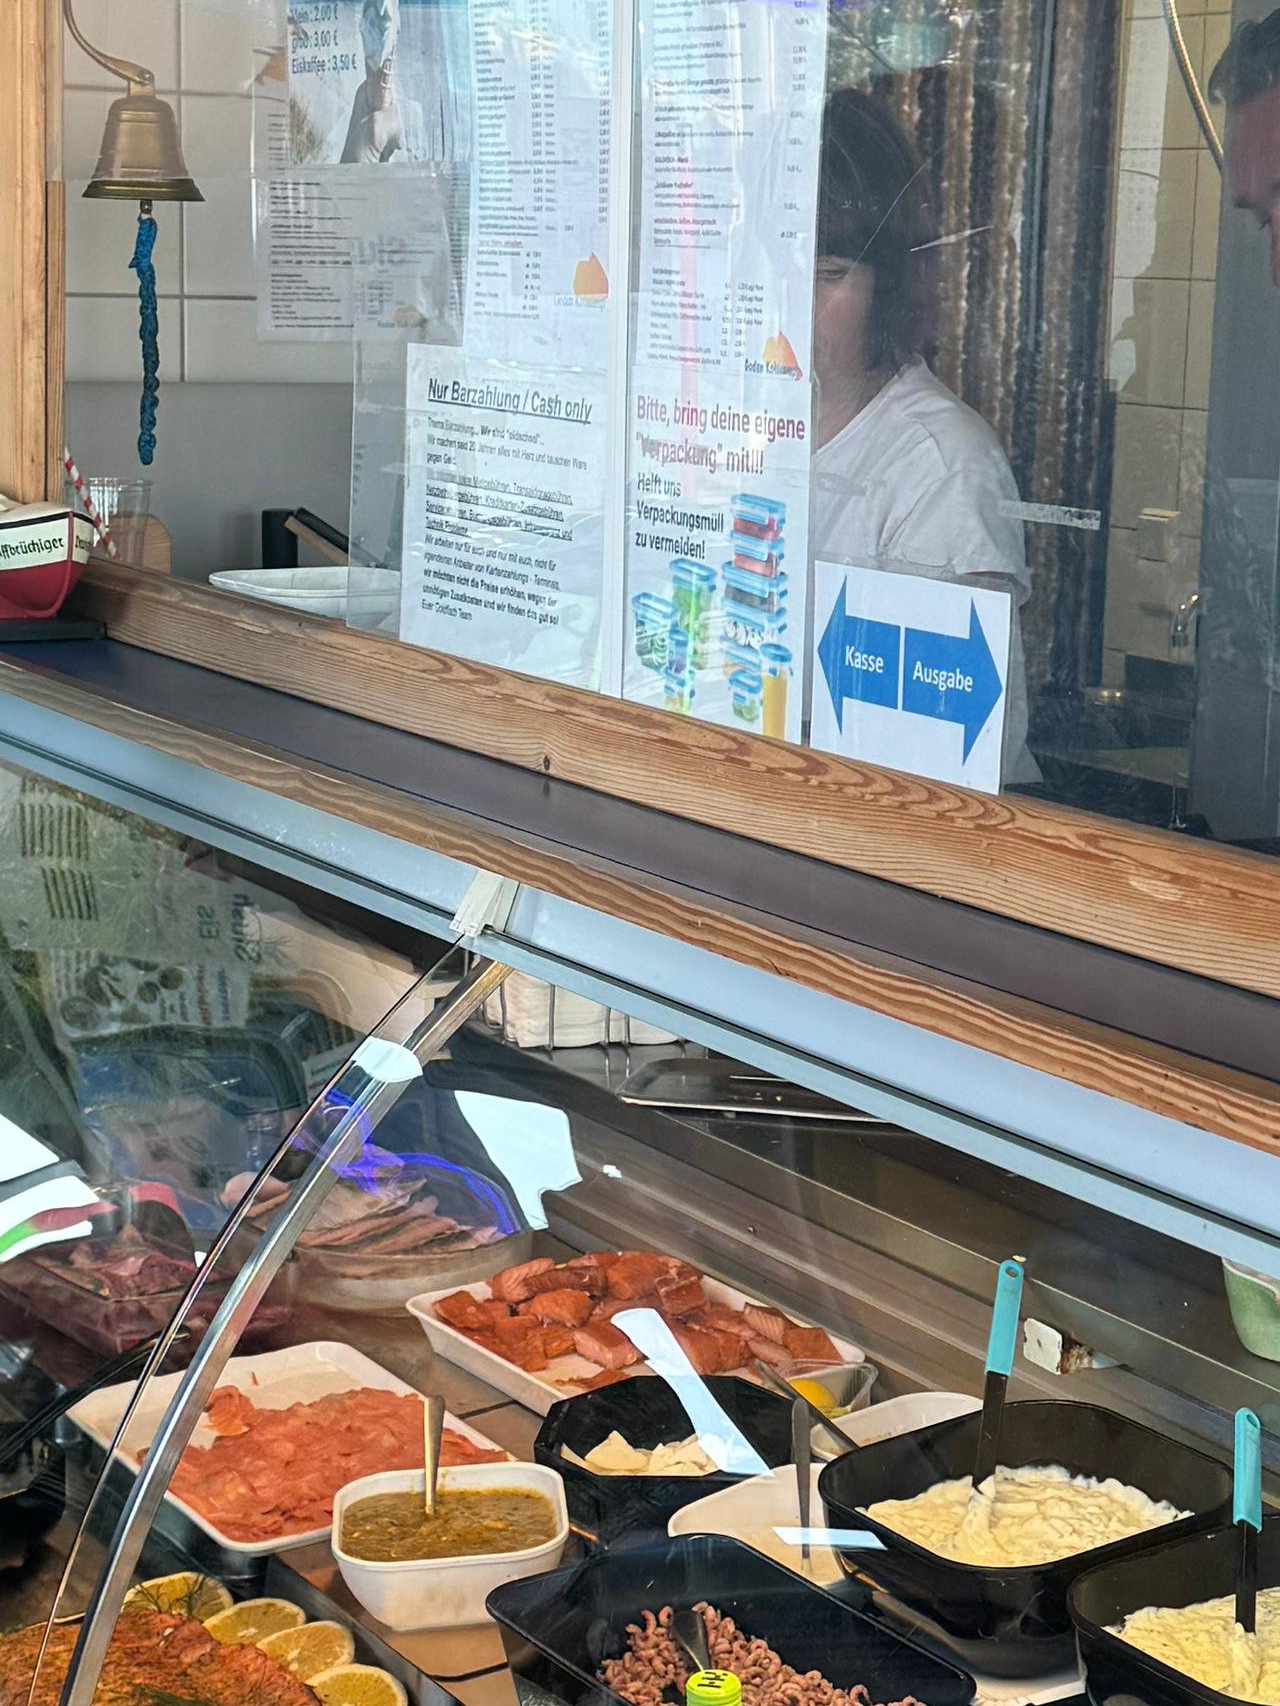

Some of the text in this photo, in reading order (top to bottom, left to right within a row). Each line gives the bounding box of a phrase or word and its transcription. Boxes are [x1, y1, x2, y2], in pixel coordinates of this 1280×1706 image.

[332, 54, 350, 74] 3,50
[428, 377, 449, 400] Nur
[451, 380, 520, 411] Barzahlung
[531, 391, 562, 416] Cash
[565, 397, 593, 423] only
[480, 425, 491, 436] Wir
[636, 394, 806, 443] Bitte, bring deine eigene
[637, 472, 681, 497] Helft uns
[636, 500, 725, 534] Verpackungsmüll
[635, 531, 706, 560] zu vermeiden!
[485, 549, 498, 560] und
[508, 552, 519, 563] mit
[534, 557, 548, 570] nicht
[456, 574, 470, 588] nicht
[470, 577, 480, 590] die
[480, 579, 499, 594] Preise
[421, 598, 434, 611] Euer
[483, 599, 496, 611] und
[496, 603, 507, 613] wir
[507, 602, 526, 618] finden
[538, 612, 549, 625] gut
[844, 645, 885, 674] Kasse
[912, 660, 974, 693] Ausgabe
